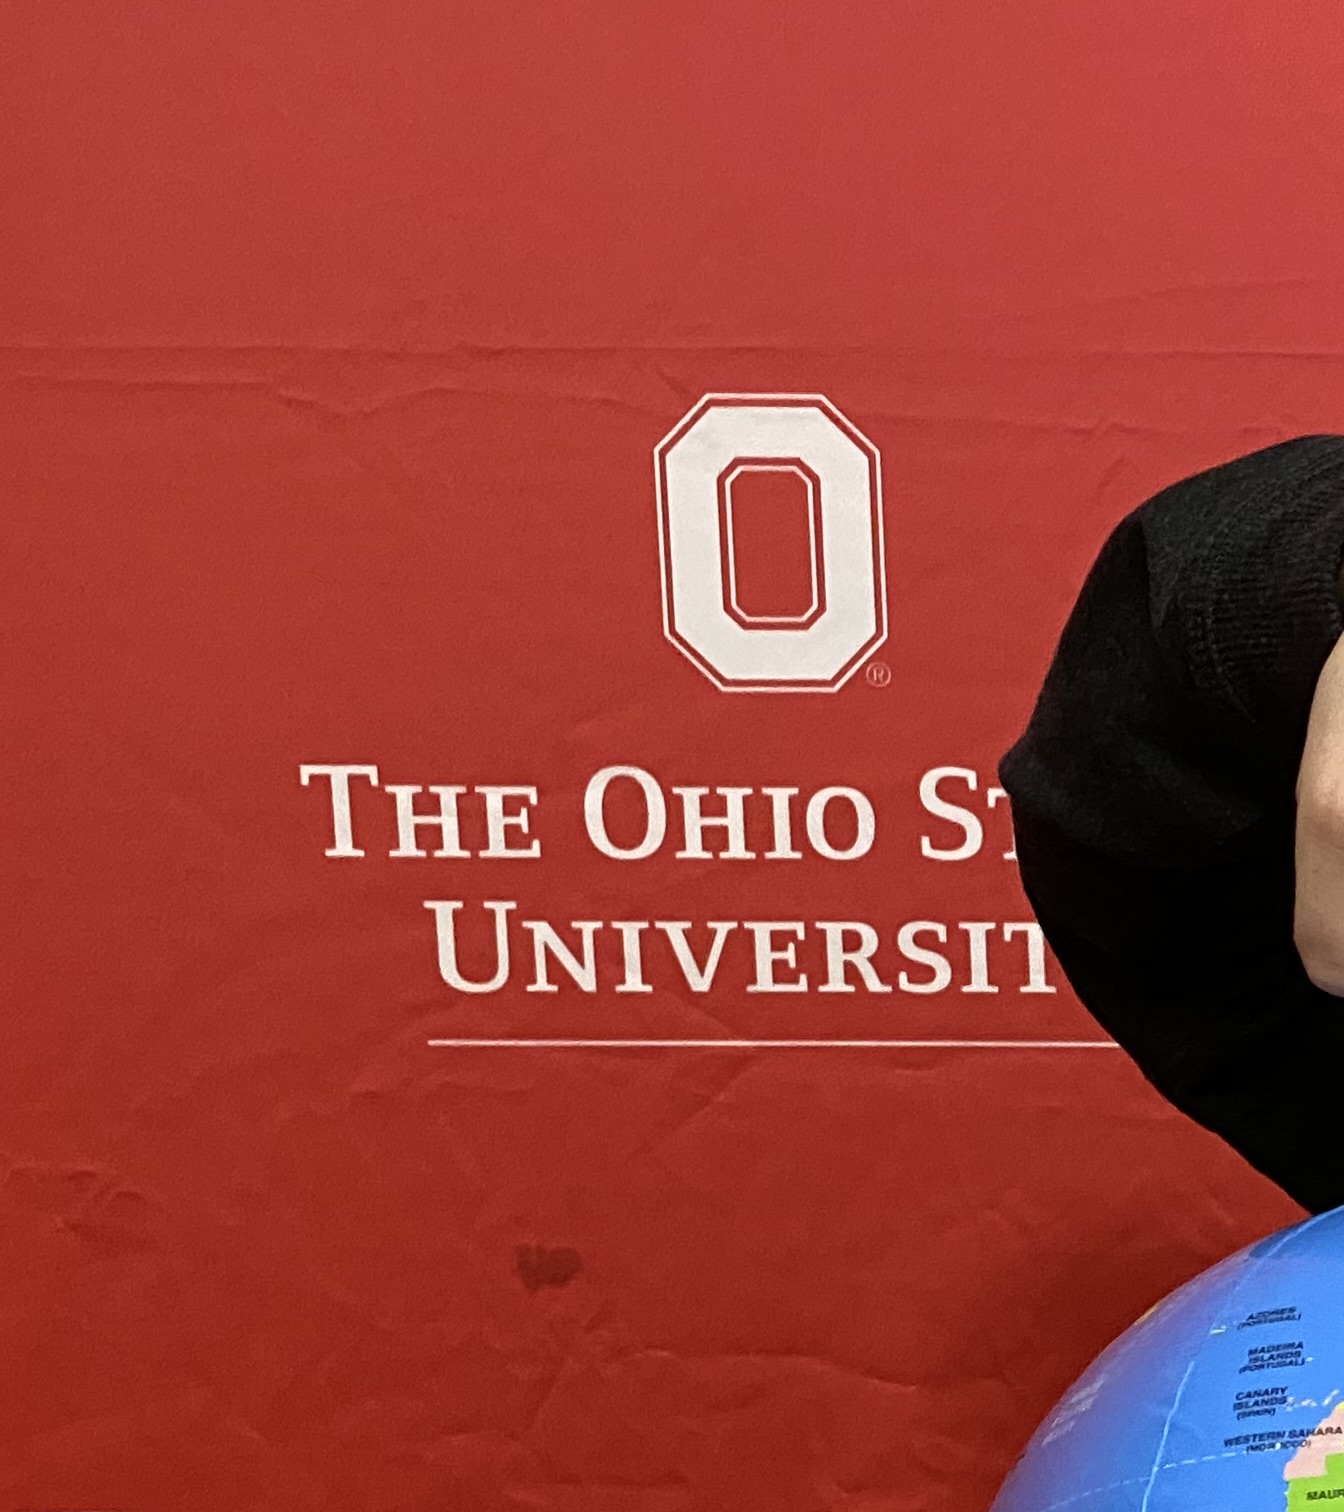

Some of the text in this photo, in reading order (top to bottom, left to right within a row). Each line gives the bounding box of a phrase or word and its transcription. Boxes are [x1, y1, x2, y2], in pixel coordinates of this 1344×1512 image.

[300, 765, 540, 857] THE
[584, 766, 875, 860] OHIO
[424, 901, 1056, 993] UNIVERSIT
[1235, 1386, 1289, 1401] CANARY
[1223, 1426, 1343, 1447] WESTERN SAHARA
